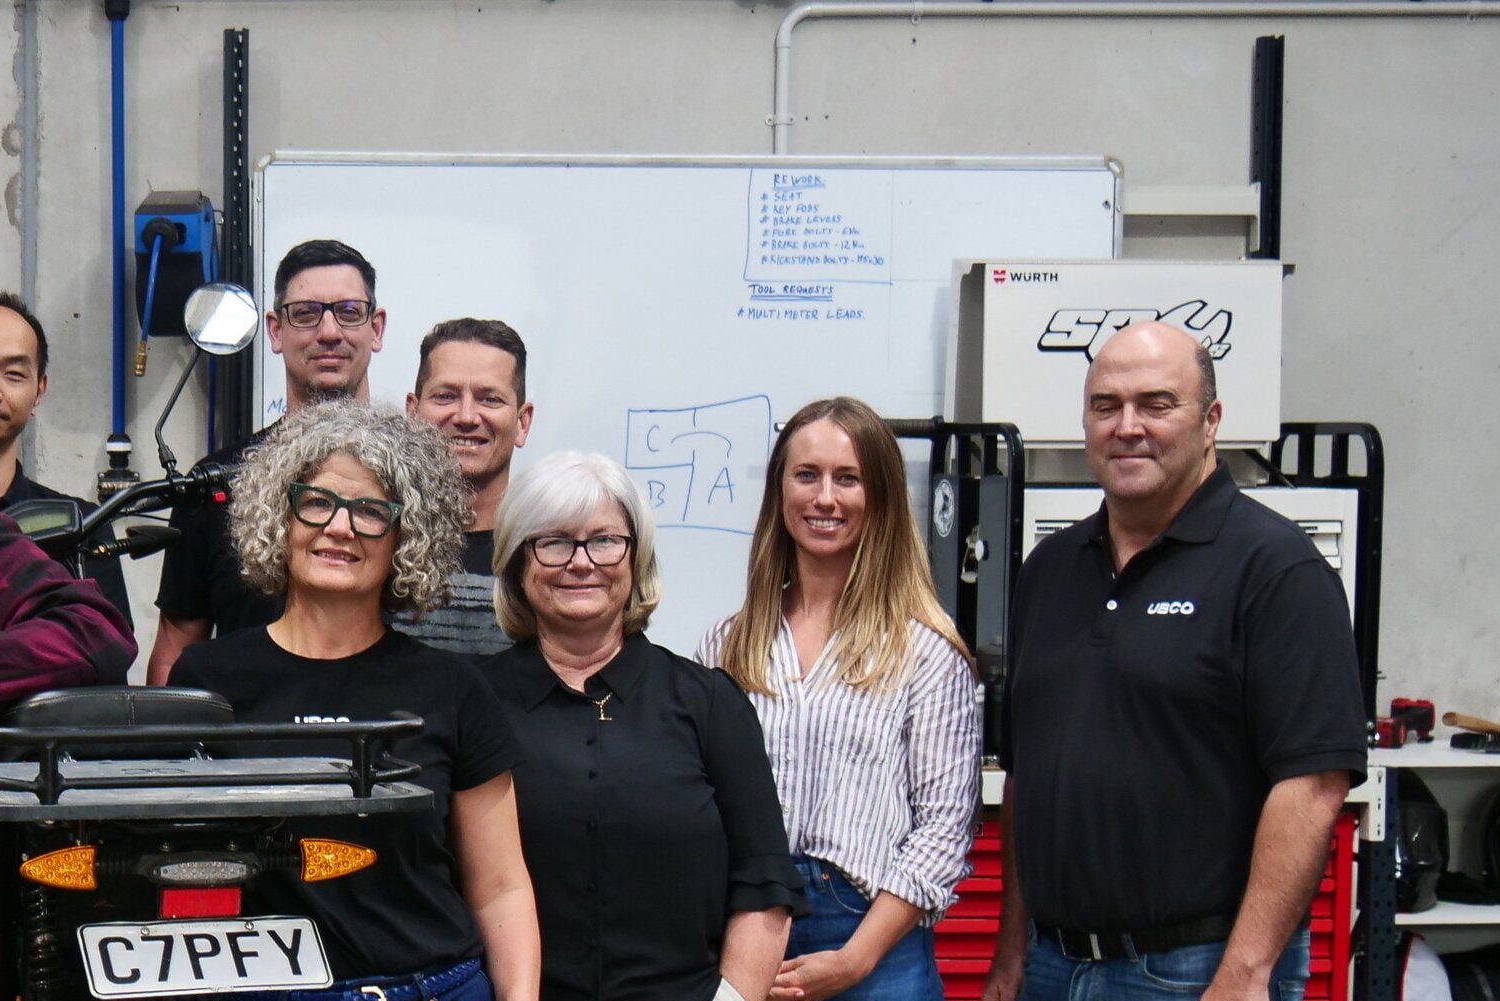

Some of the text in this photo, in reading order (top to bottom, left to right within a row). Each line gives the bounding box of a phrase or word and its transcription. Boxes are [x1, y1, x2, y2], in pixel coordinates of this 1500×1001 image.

[773, 204, 791, 215] KEY
[748, 284, 834, 295] TOOL REQUESTS
[646, 424, 661, 453] C
[647, 480, 666, 508] B
[707, 466, 736, 505] A
[1146, 601, 1195, 615] UBCO
[98, 928, 303, 985] C7PFY
